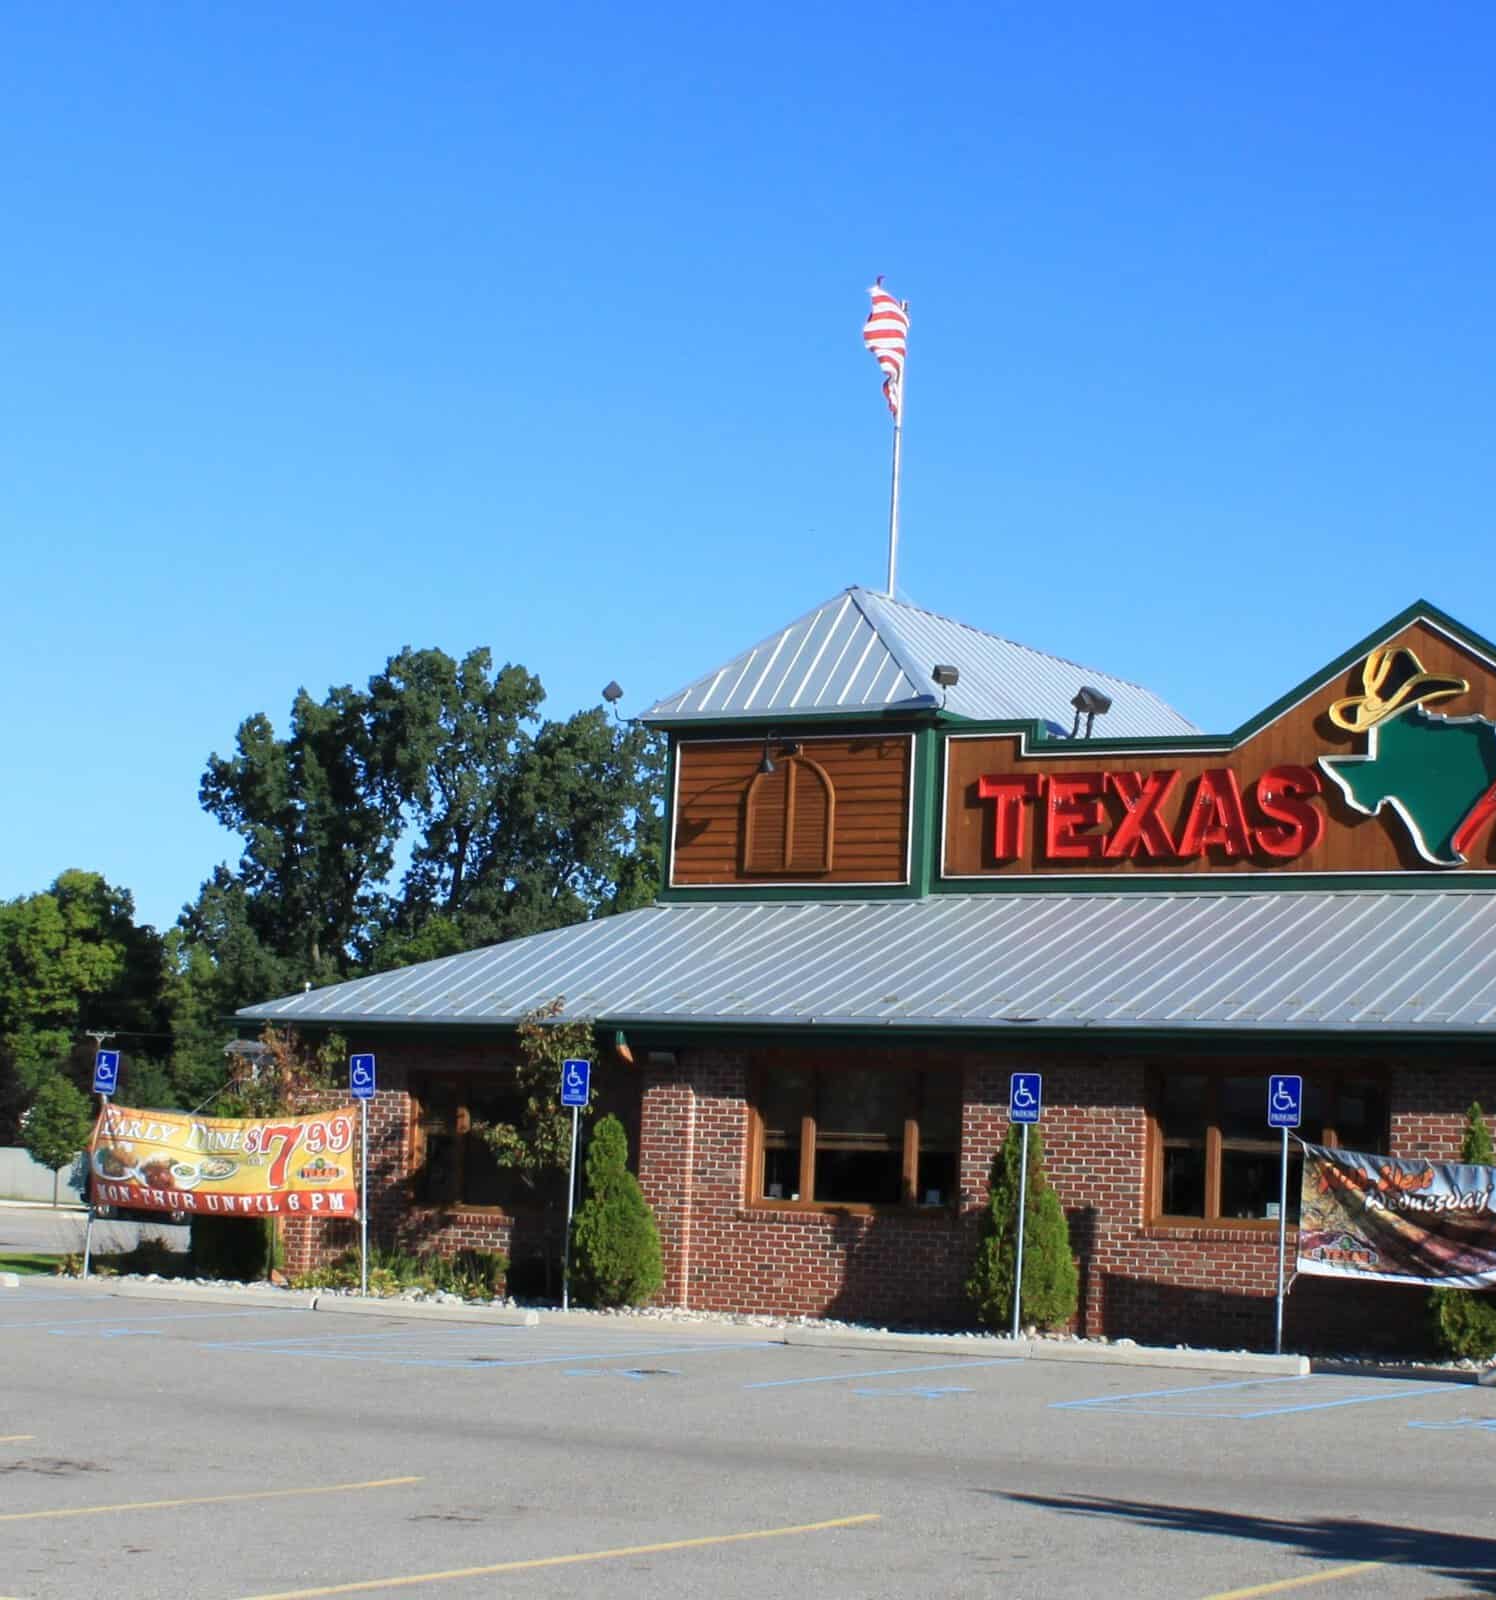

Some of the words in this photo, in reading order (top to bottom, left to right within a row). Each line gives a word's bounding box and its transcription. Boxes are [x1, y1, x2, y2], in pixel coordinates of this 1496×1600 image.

[978, 765, 1328, 859] TEXAS
[205, 1195, 279, 1212] UNTIL
[288, 1193, 299, 1210] 6
[311, 1193, 345, 1210] PM
